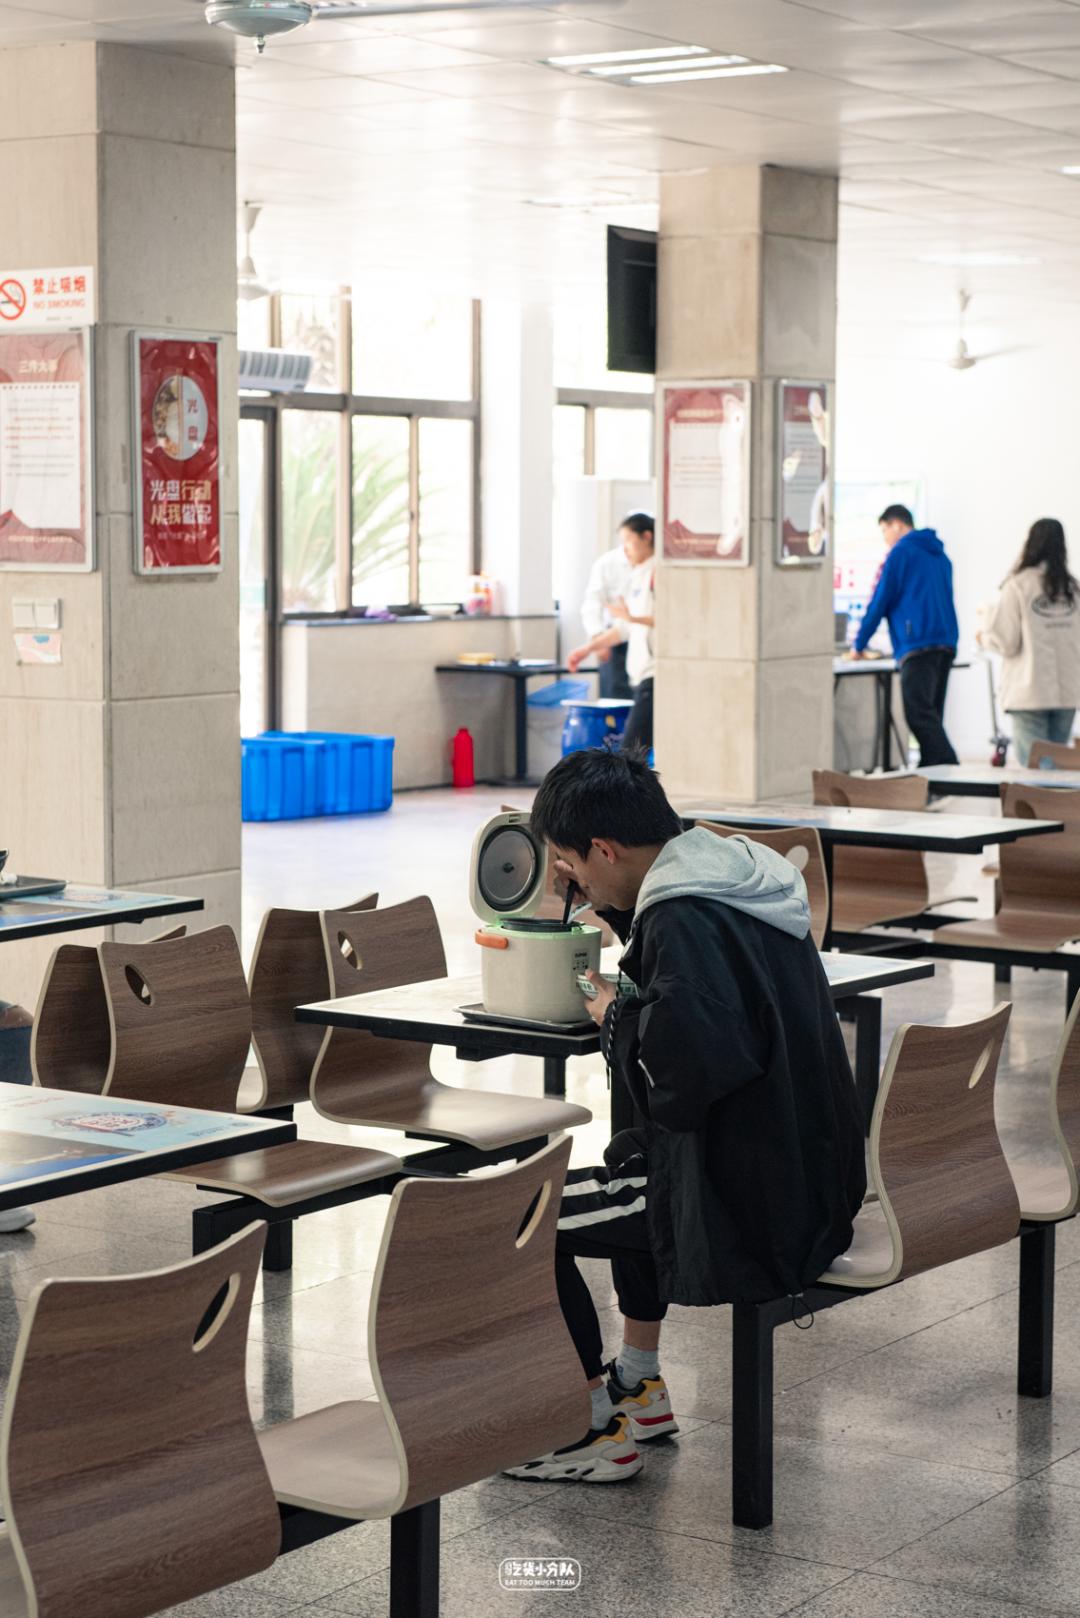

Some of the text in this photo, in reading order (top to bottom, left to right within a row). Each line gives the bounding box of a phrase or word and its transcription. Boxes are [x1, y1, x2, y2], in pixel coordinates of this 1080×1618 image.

[33, 276, 86, 295] 禁止吸烟
[33, 299, 85, 309] NO SMOKING
[150, 480, 212, 501] 光盘行动
[150, 503, 212, 525] 从我做起
